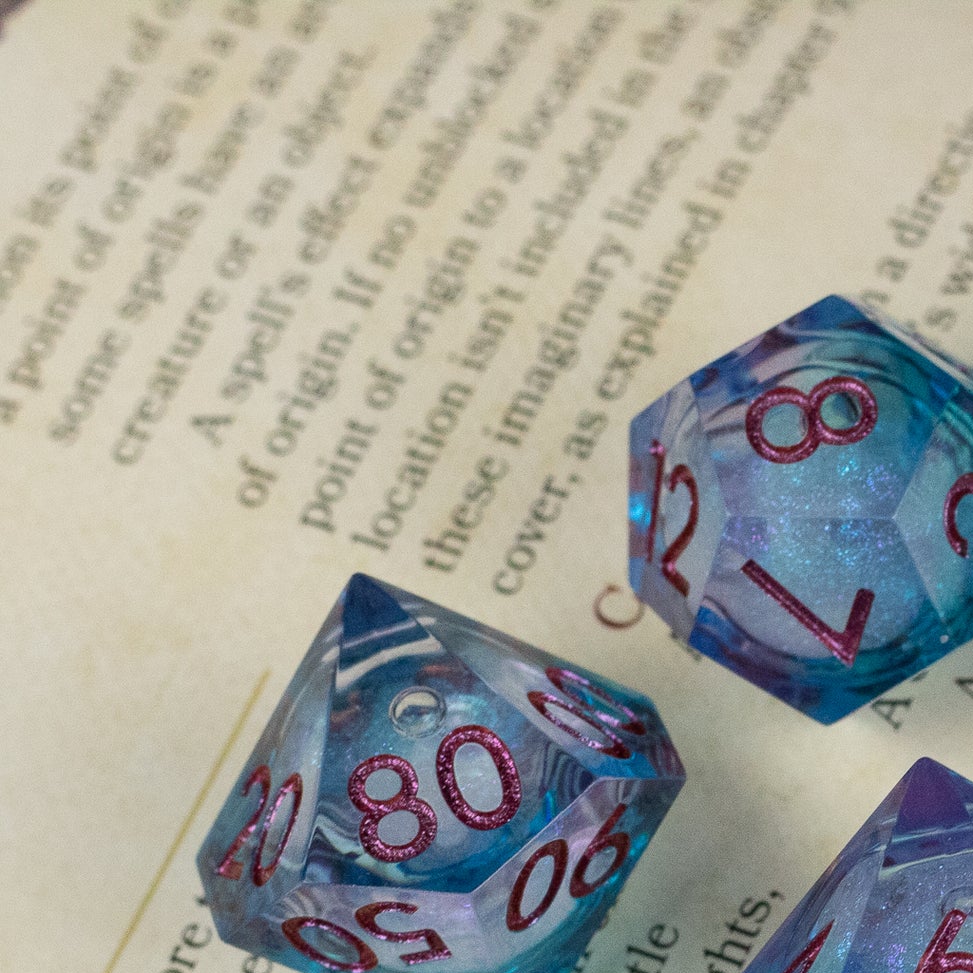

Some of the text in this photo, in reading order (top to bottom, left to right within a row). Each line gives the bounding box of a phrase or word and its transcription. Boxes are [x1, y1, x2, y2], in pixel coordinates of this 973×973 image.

[112, 287, 226, 466] creature
[219, 272, 312, 404] spell's
[298, 236, 481, 535] point of origin
[422, 455, 510, 573] these
[481, 237, 632, 450] imaginary
[492, 201, 724, 597] cover, as explained
[745, 376, 878, 464] 8
[350, 381, 475, 553] location
[649, 439, 699, 597] 12
[216, 763, 303, 888] 20
[347, 723, 523, 863] 80
